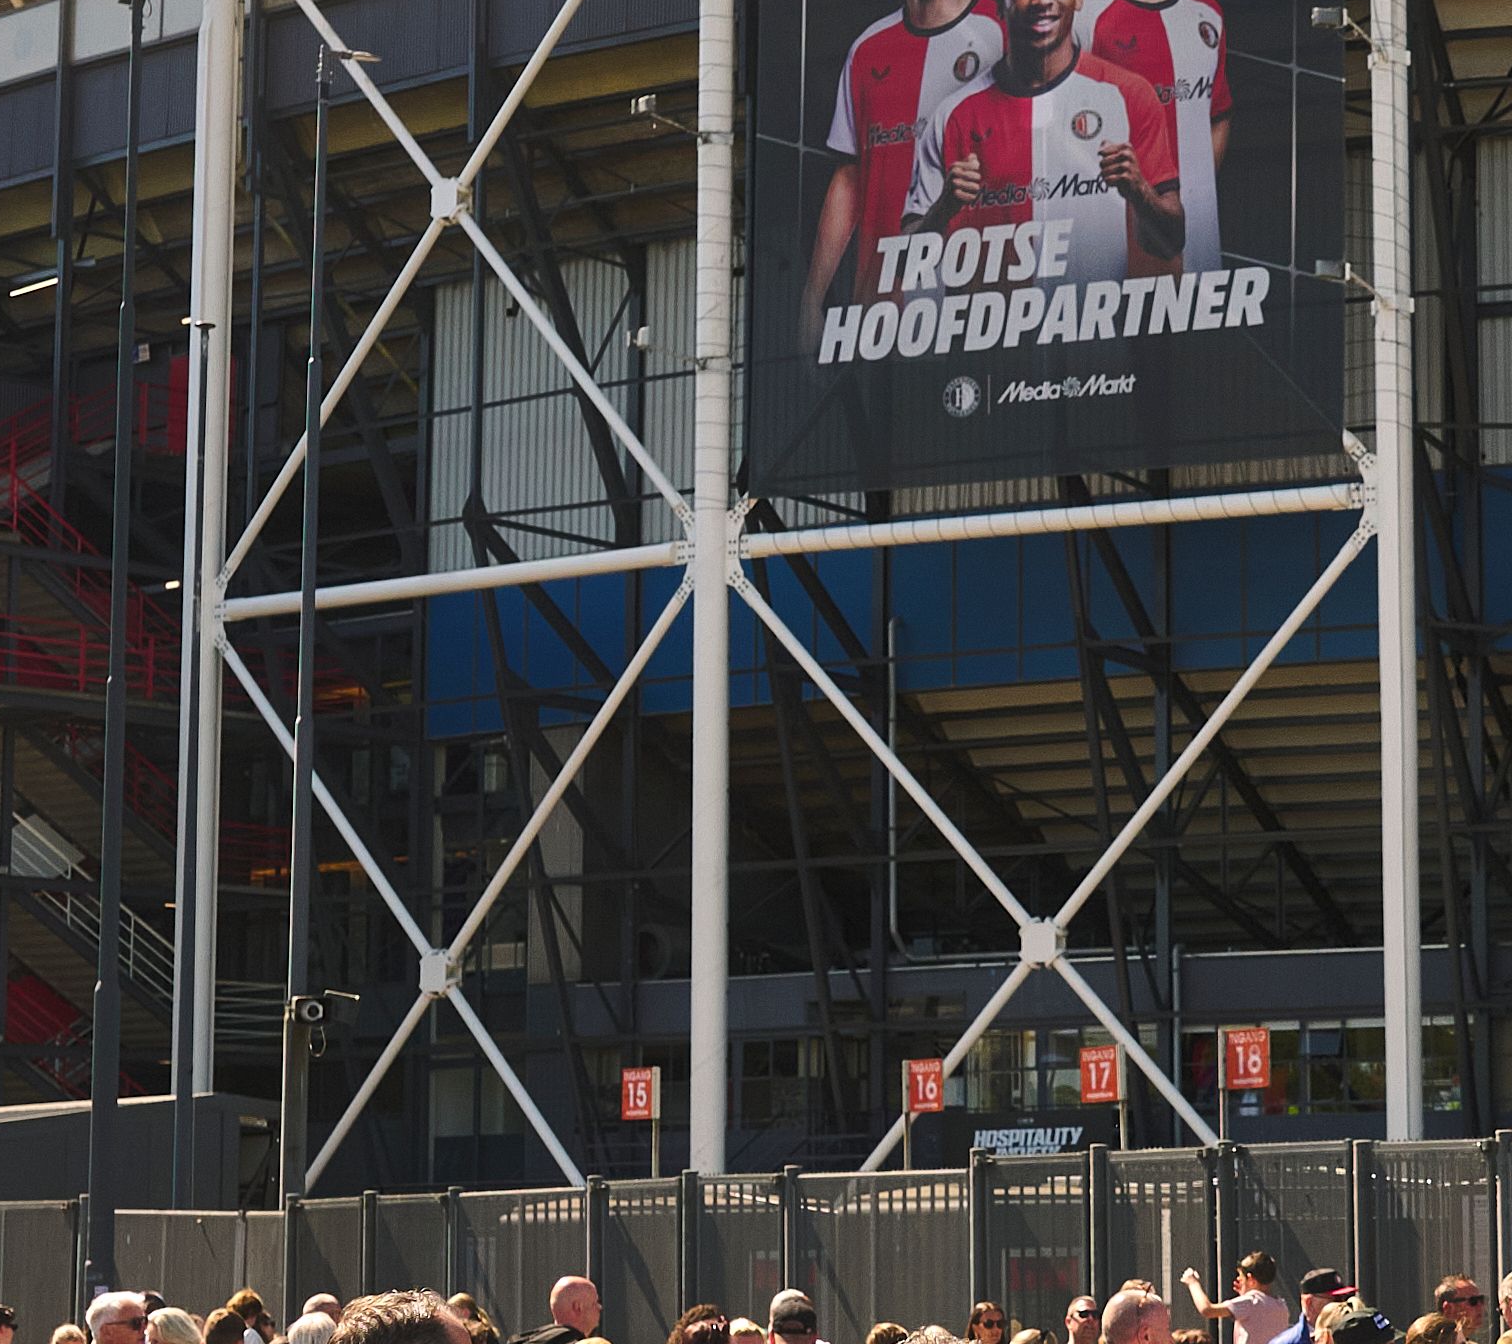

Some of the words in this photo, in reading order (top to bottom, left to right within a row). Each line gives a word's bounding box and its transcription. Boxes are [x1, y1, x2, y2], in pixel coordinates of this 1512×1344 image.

[1047, 172, 1110, 200] Mark
[877, 220, 1073, 293] TROTSE
[818, 267, 1270, 364] HOOFDPARTNER
[997, 381, 1061, 404] Media
[1079, 374, 1136, 397] Markt
[1235, 1044, 1261, 1075] 18
[917, 1074, 937, 1100] 16
[1089, 1062, 1110, 1090] 17
[627, 1082, 647, 1107] 15
[974, 1127, 1083, 1147] HOSPITALITY
